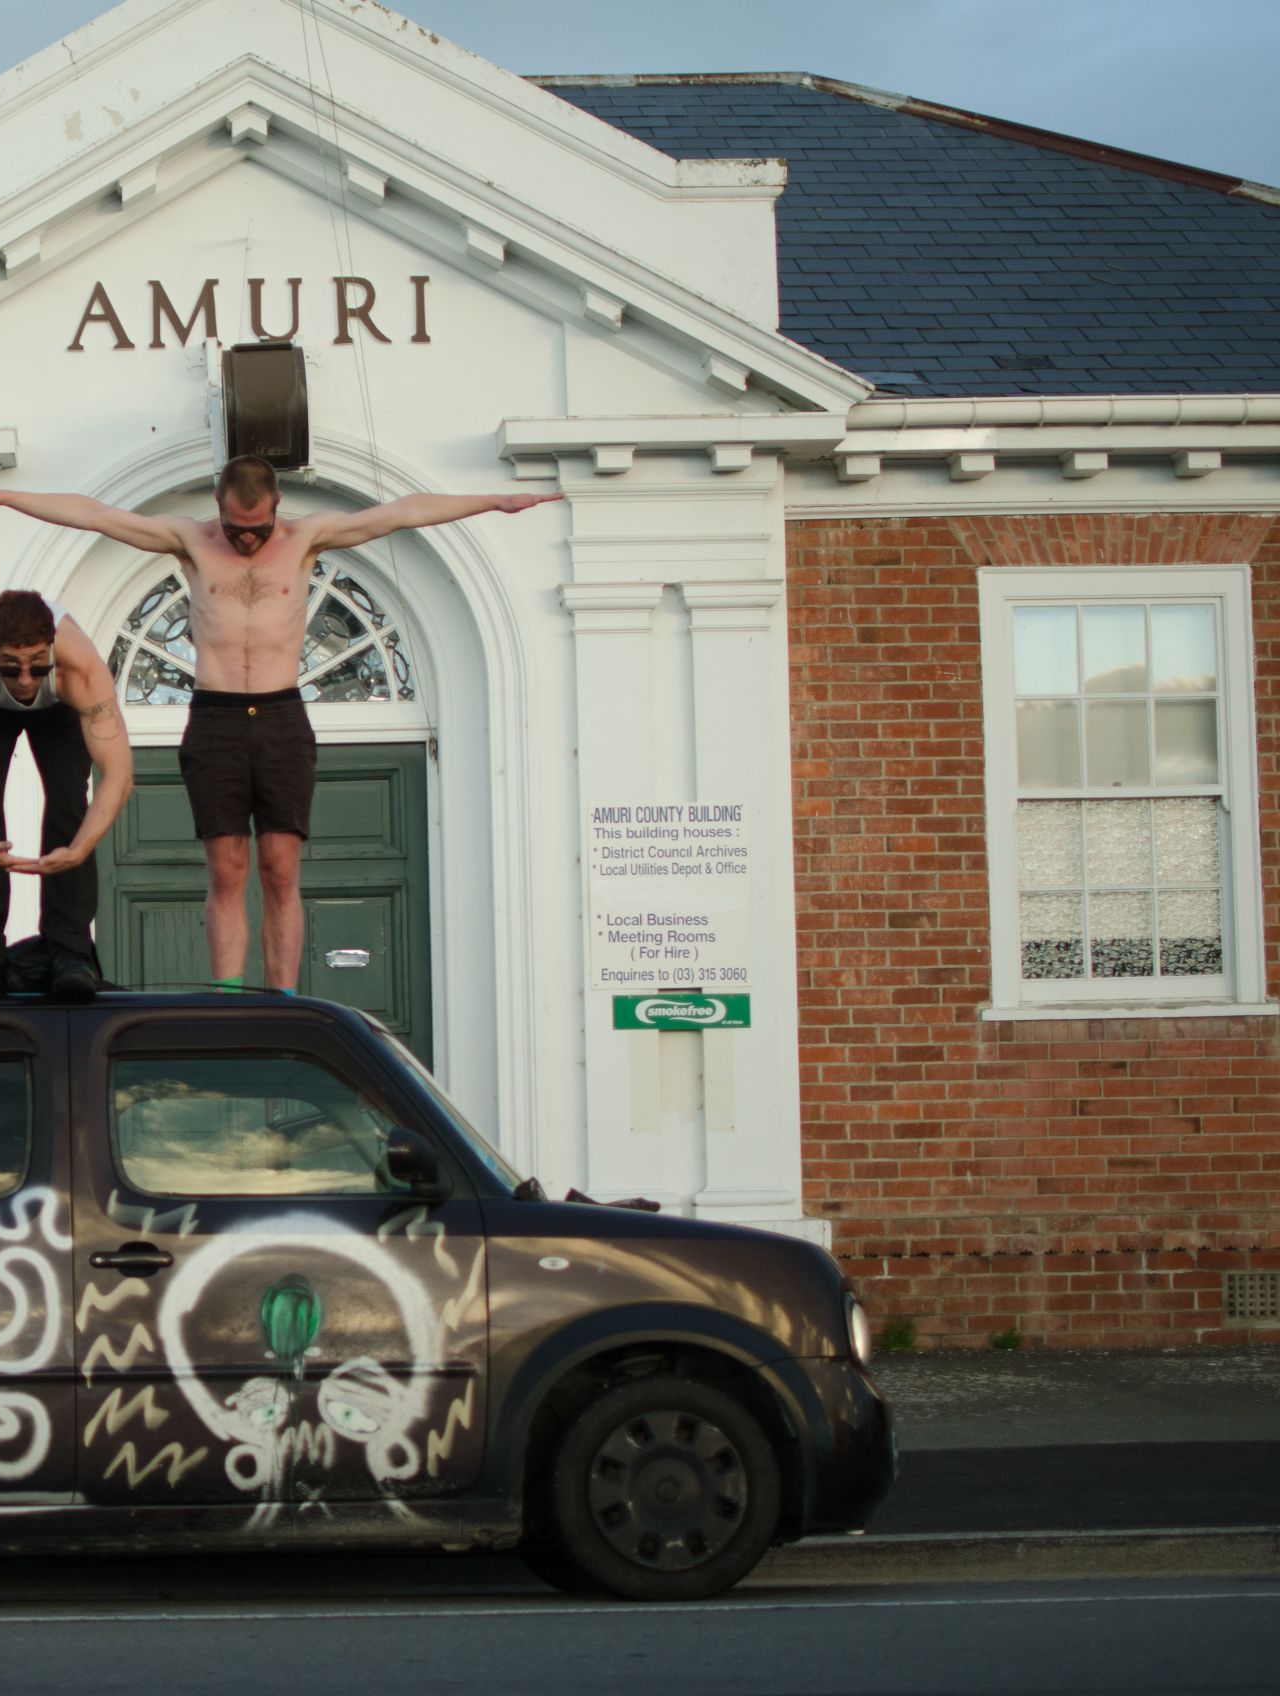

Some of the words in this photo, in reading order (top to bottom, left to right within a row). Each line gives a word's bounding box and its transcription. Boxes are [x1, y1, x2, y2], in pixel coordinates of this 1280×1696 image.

[67, 275, 432, 352] AMURI
[593, 807, 631, 823] AMURI
[636, 806, 683, 823] COUNTY
[688, 805, 741, 822] BUILDING
[593, 827, 622, 839] This
[626, 826, 679, 840] building
[683, 826, 732, 838] houses
[602, 846, 644, 859] District
[648, 845, 692, 858] Council
[696, 845, 747, 858] Archives
[600, 863, 627, 876] Local
[630, 863, 669, 876] Utilities
[671, 862, 702, 877] Depot
[705, 862, 712, 875] &
[716, 861, 747, 875] Office
[607, 913, 642, 926] Local
[647, 913, 708, 926] Business
[608, 930, 663, 946] Meeting
[667, 929, 716, 943] Rooms
[639, 946, 660, 959] For
[664, 946, 690, 959] Hire
[601, 968, 654, 984] Enquiries
[658, 969, 669, 980] to
[673, 967, 694, 984] (03)
[698, 967, 716, 981] 315
[720, 967, 747, 981] 3060
[647, 1006, 714, 1016] smokefree
